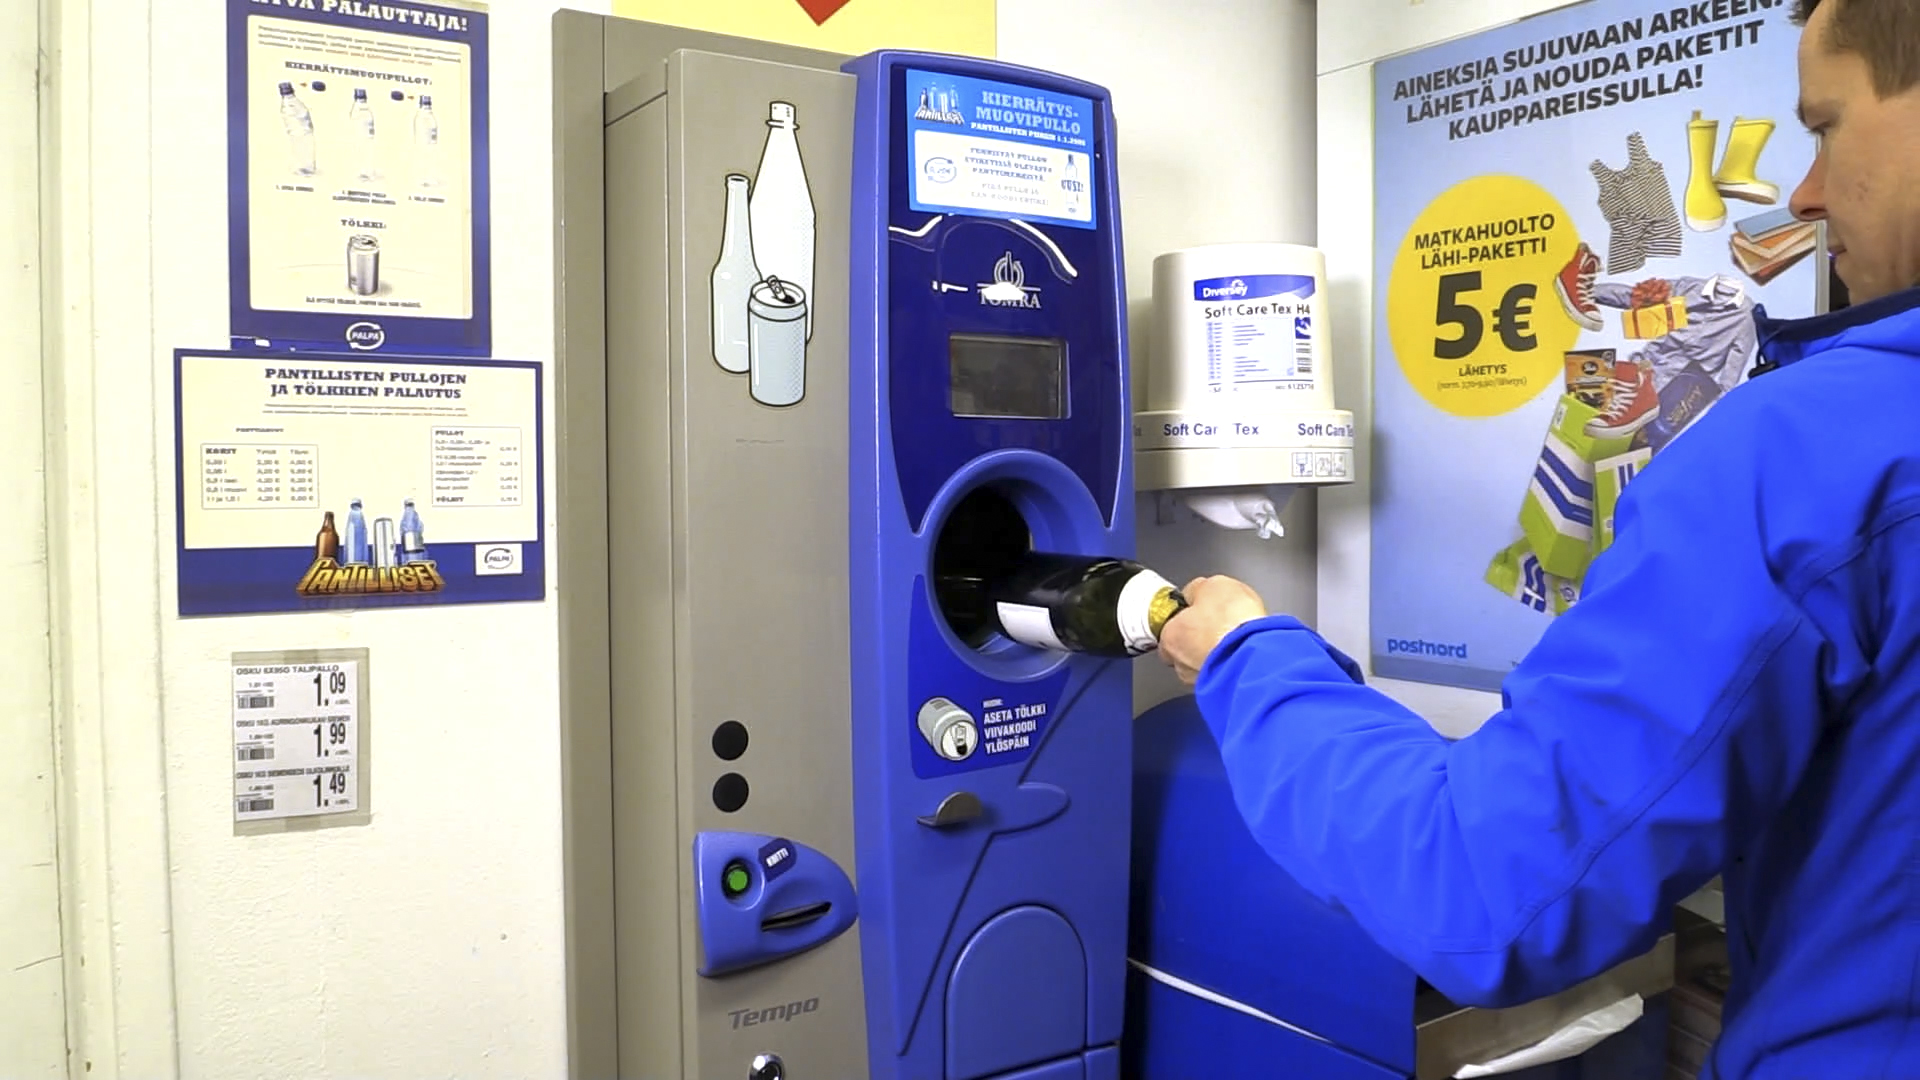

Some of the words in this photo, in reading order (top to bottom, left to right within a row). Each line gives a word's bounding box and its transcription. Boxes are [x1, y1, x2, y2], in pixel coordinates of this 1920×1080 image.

[322, 0, 468, 31] PALAUTTAJA!
[1393, 57, 1499, 101] AINEKSIA
[1503, 19, 1642, 74] SUJUVAAN
[1648, 0, 1784, 37] ARKEE
[1407, 79, 1496, 124] LÄHETÄ
[1500, 77, 1528, 102] JA
[1533, 52, 1631, 93] NOUDA
[1637, 19, 1765, 69] PAKETIT
[981, 90, 1079, 118] KIERRÄTYS-
[1449, 64, 1703, 140] KAUPPAREISSULLA!
[975, 105, 1081, 135] MUOVIPULLO
[1415, 213, 1555, 250] MATKAHUOLTO
[1421, 237, 1547, 270] LÄHI-PAKETTI
[1202, 284, 1248, 298] Diversey
[1204, 305, 1232, 319] Soft
[1237, 304, 1268, 316] Care
[1271, 302, 1292, 315] Tex
[1296, 303, 1311, 315] H4
[265, 368, 384, 382] PANTILLISTEN
[390, 372, 466, 386] PULLOJEN
[1459, 364, 1507, 376] LÄHETYS
[271, 384, 288, 397] JA
[294, 381, 378, 397] TÖLKKIEN
[384, 386, 461, 399] PALAUTUS
[1163, 423, 1189, 436] Soft
[1233, 422, 1259, 436] Tex
[1298, 423, 1323, 436] Soft
[298, 558, 446, 595] PANTILLISET
[1387, 637, 1468, 659] postnord
[313, 671, 346, 707] 1.09
[983, 709, 1013, 725] ASETA
[1014, 703, 1046, 719] TÖLKKI
[313, 722, 346, 758] 1.99
[984, 719, 1037, 739] VIIVAKOODI
[985, 735, 1030, 754] YLÖSPÄIN
[313, 773, 346, 808] 1.49
[728, 997, 821, 1031] Tempo
